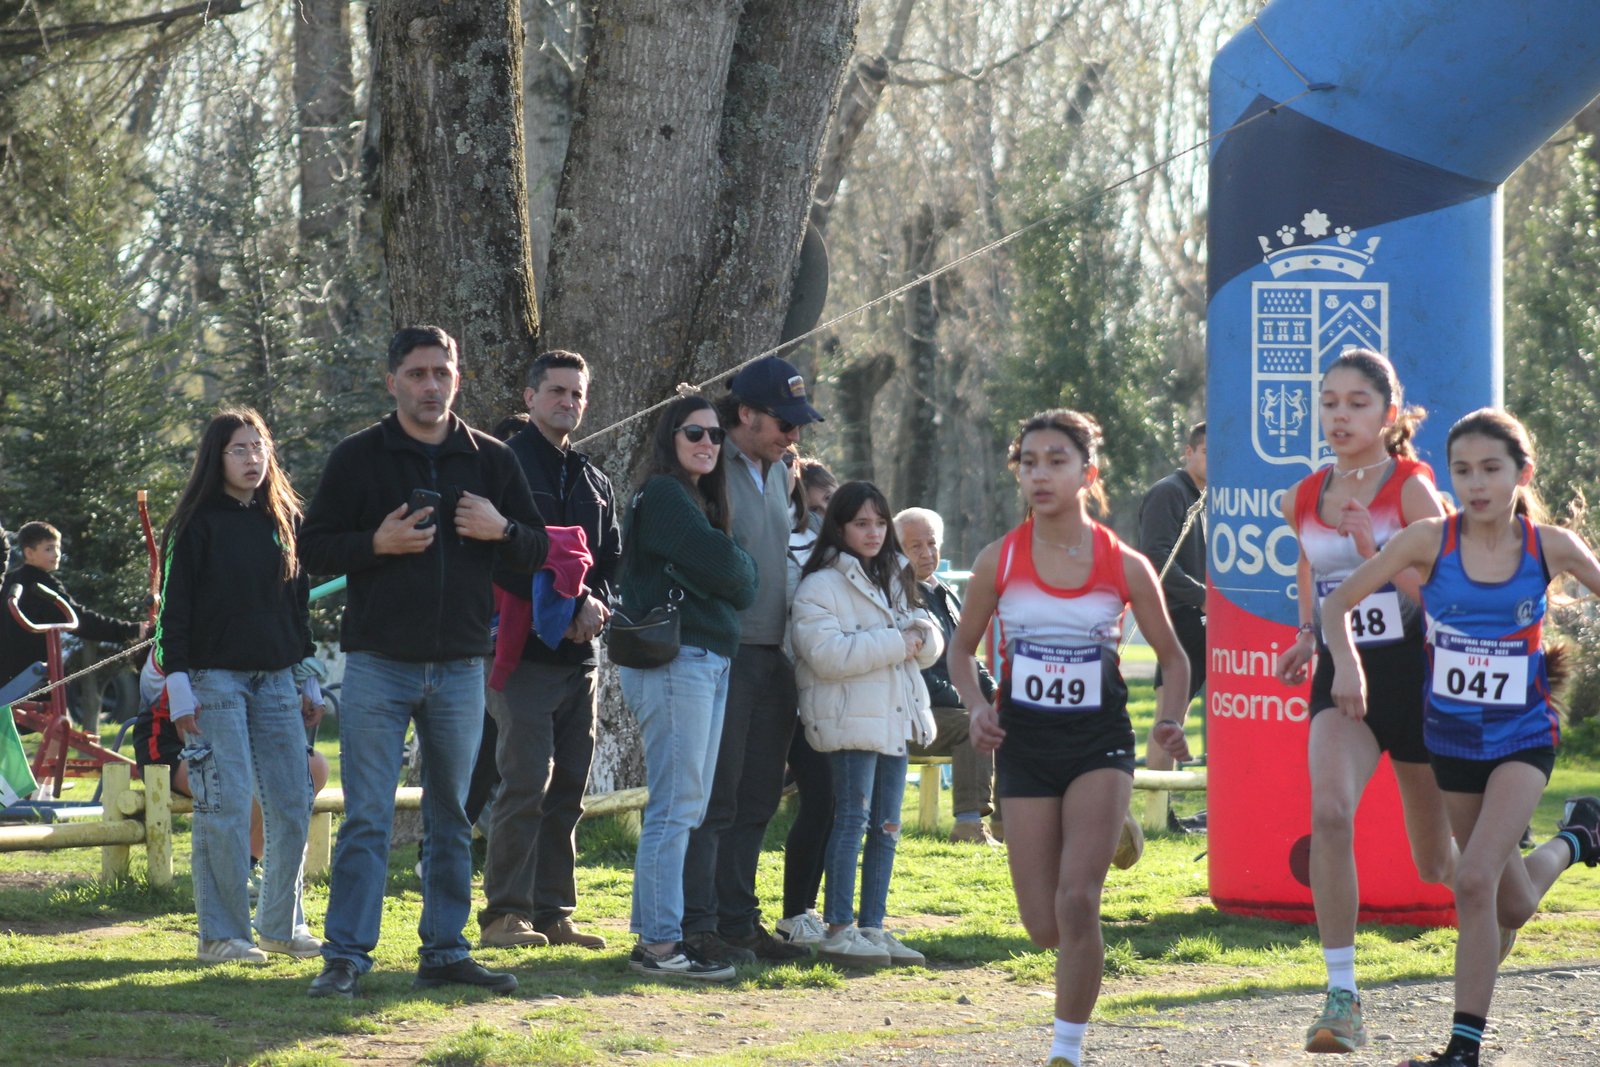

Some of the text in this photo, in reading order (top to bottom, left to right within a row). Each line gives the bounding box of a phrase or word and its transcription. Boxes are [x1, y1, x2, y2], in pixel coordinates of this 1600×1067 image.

[1211, 486, 1289, 518] MUNIC
[1211, 522, 1299, 577] OSO
[1350, 607, 1387, 637] 48
[1029, 644, 1097, 656] REGIONAL CROSS COUNTRY
[1449, 636, 1524, 648] REGIONAL CROSS COUNTRY
[1465, 646, 1489, 655] OSORNO
[1041, 654, 1065, 662] OSORNO
[1045, 664, 1065, 673] U14
[1468, 656, 1489, 667] U14
[1025, 674, 1085, 706] 049
[1446, 667, 1510, 701] 047
[1211, 691, 1309, 722] osorno
